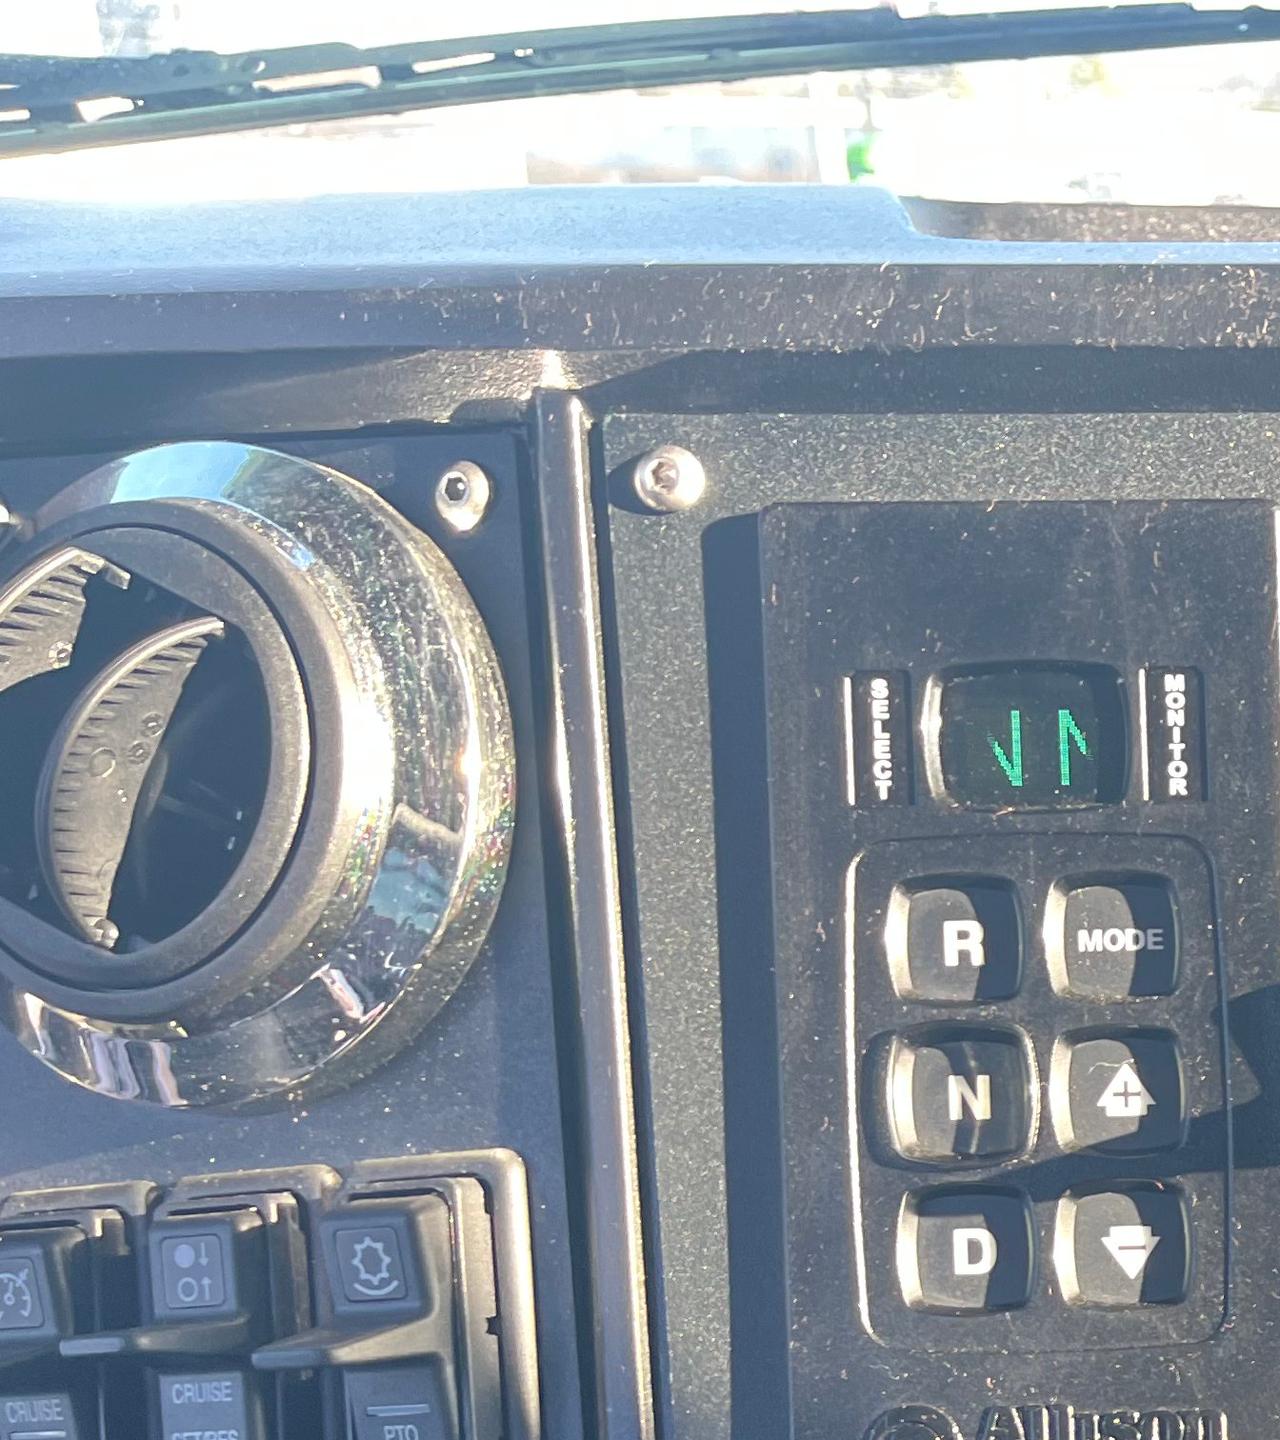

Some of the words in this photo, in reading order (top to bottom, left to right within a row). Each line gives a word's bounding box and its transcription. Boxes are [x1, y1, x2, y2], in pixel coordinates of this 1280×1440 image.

[870, 678, 893, 801] SELECT
[1164, 674, 1188, 796] MONITOR
[943, 920, 985, 967] R
[1078, 929, 1164, 952] MODE
[948, 1074, 992, 1120] N
[952, 1227, 998, 1276] D
[5, 1399, 64, 1423] CRUISE
[172, 1382, 232, 1404] CRUISE
